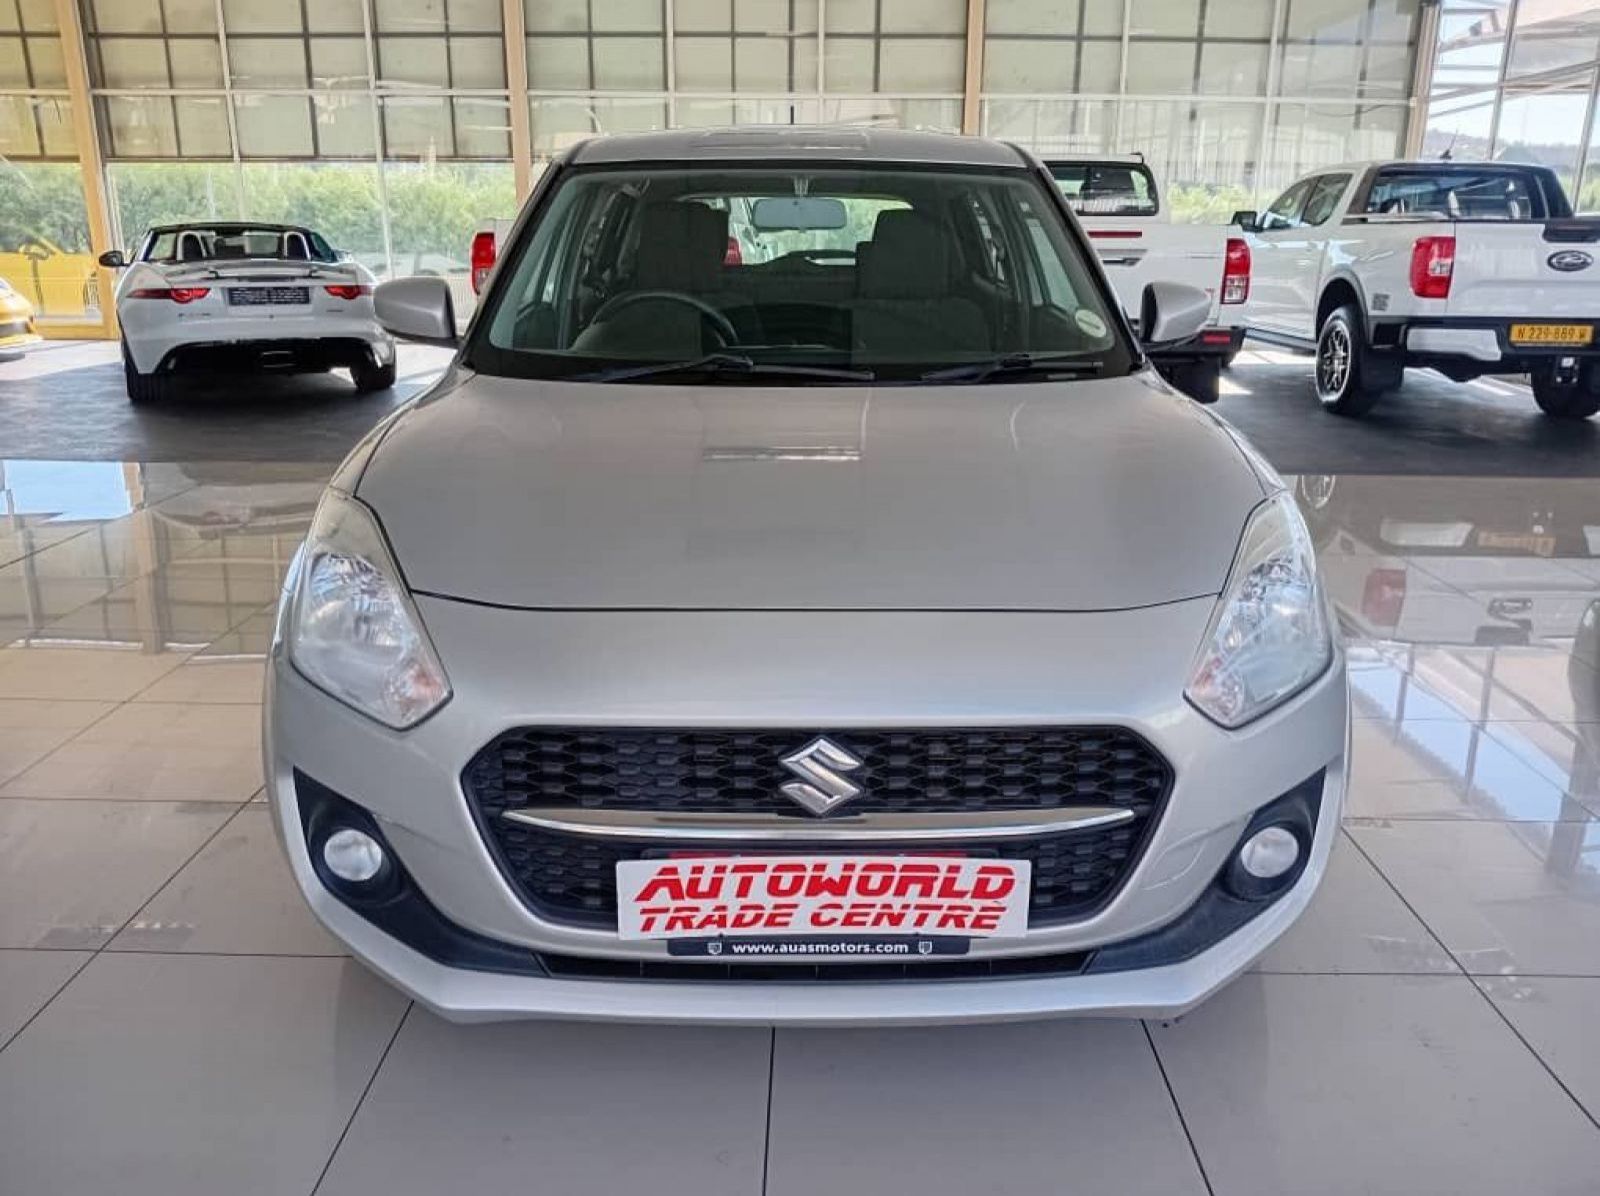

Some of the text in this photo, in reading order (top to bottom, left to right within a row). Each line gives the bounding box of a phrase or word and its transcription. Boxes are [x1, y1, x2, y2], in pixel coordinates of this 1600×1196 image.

[634, 863, 1016, 902] AUTOWORLD
[639, 903, 1007, 932] TRADE CENTRE
[732, 942, 909, 954] www.auasmotors.com
